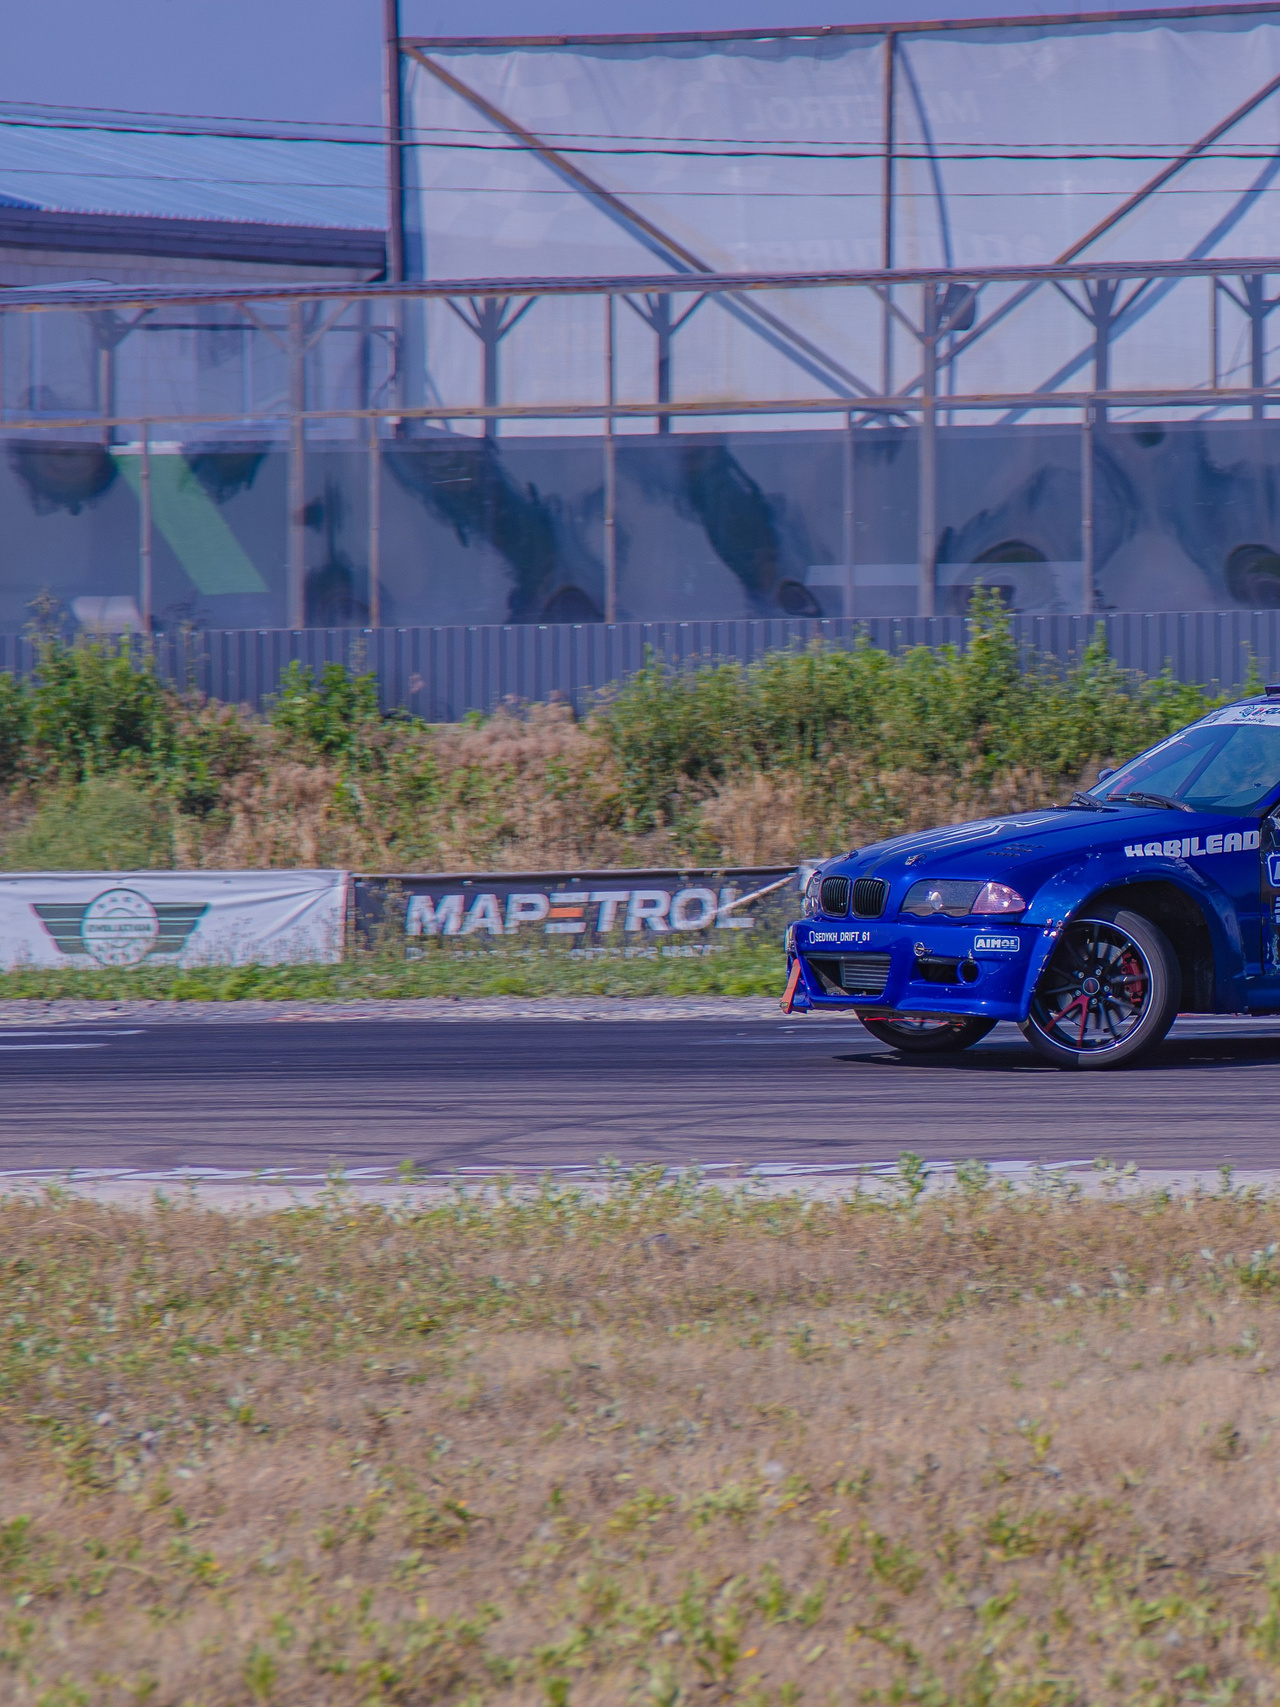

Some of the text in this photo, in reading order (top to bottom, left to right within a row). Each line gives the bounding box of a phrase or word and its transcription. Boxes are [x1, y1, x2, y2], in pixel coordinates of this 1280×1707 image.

[1124, 830, 1260, 858] HABILEAD
[405, 887, 754, 935] MAPETROL
[815, 931, 870, 945] SEDYKH_DRIFT_61
[976, 938, 1018, 949] AIMOL
